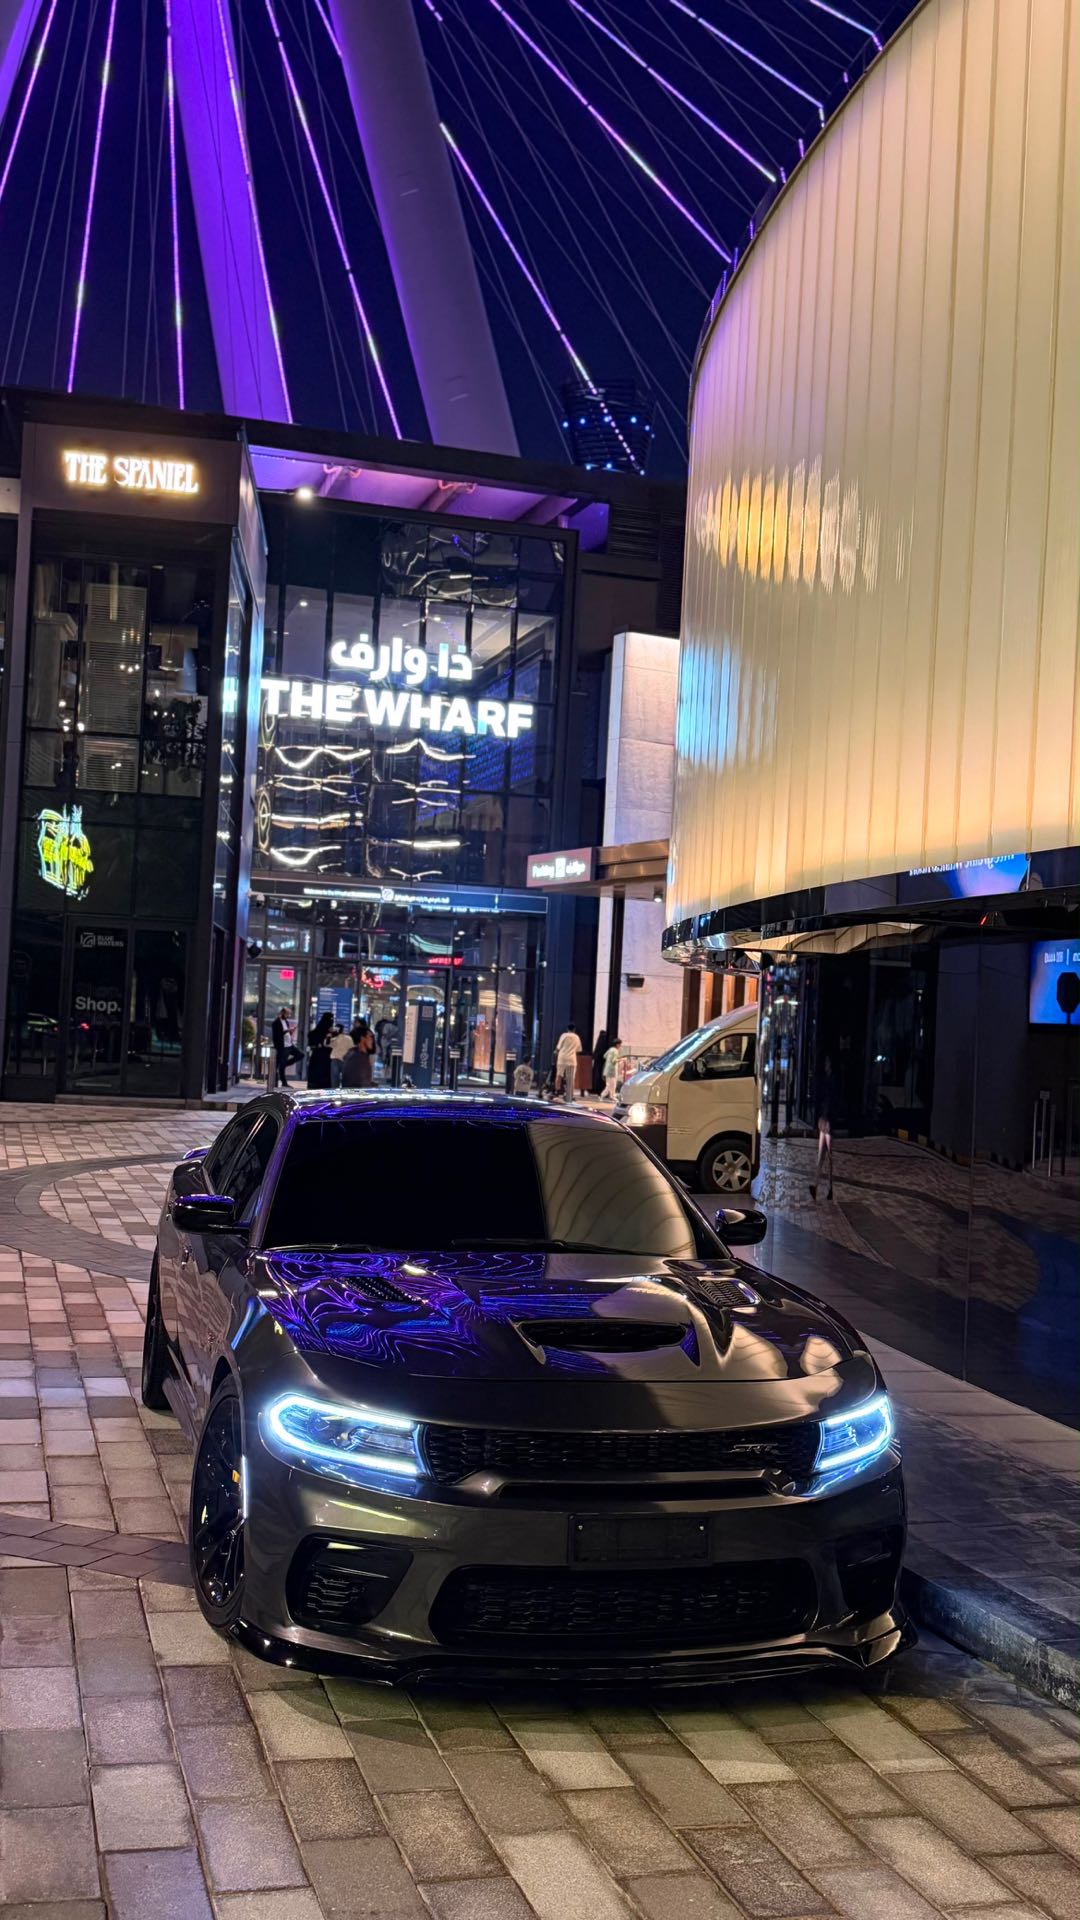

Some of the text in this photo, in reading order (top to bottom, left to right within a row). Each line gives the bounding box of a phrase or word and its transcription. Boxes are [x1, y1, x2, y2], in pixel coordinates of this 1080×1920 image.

[63, 449, 199, 493] THE SPANIEL
[330, 633, 473, 685] ذا وارف
[260, 678, 535, 739] THE WHARF
[75, 995, 122, 1015] Shop.
